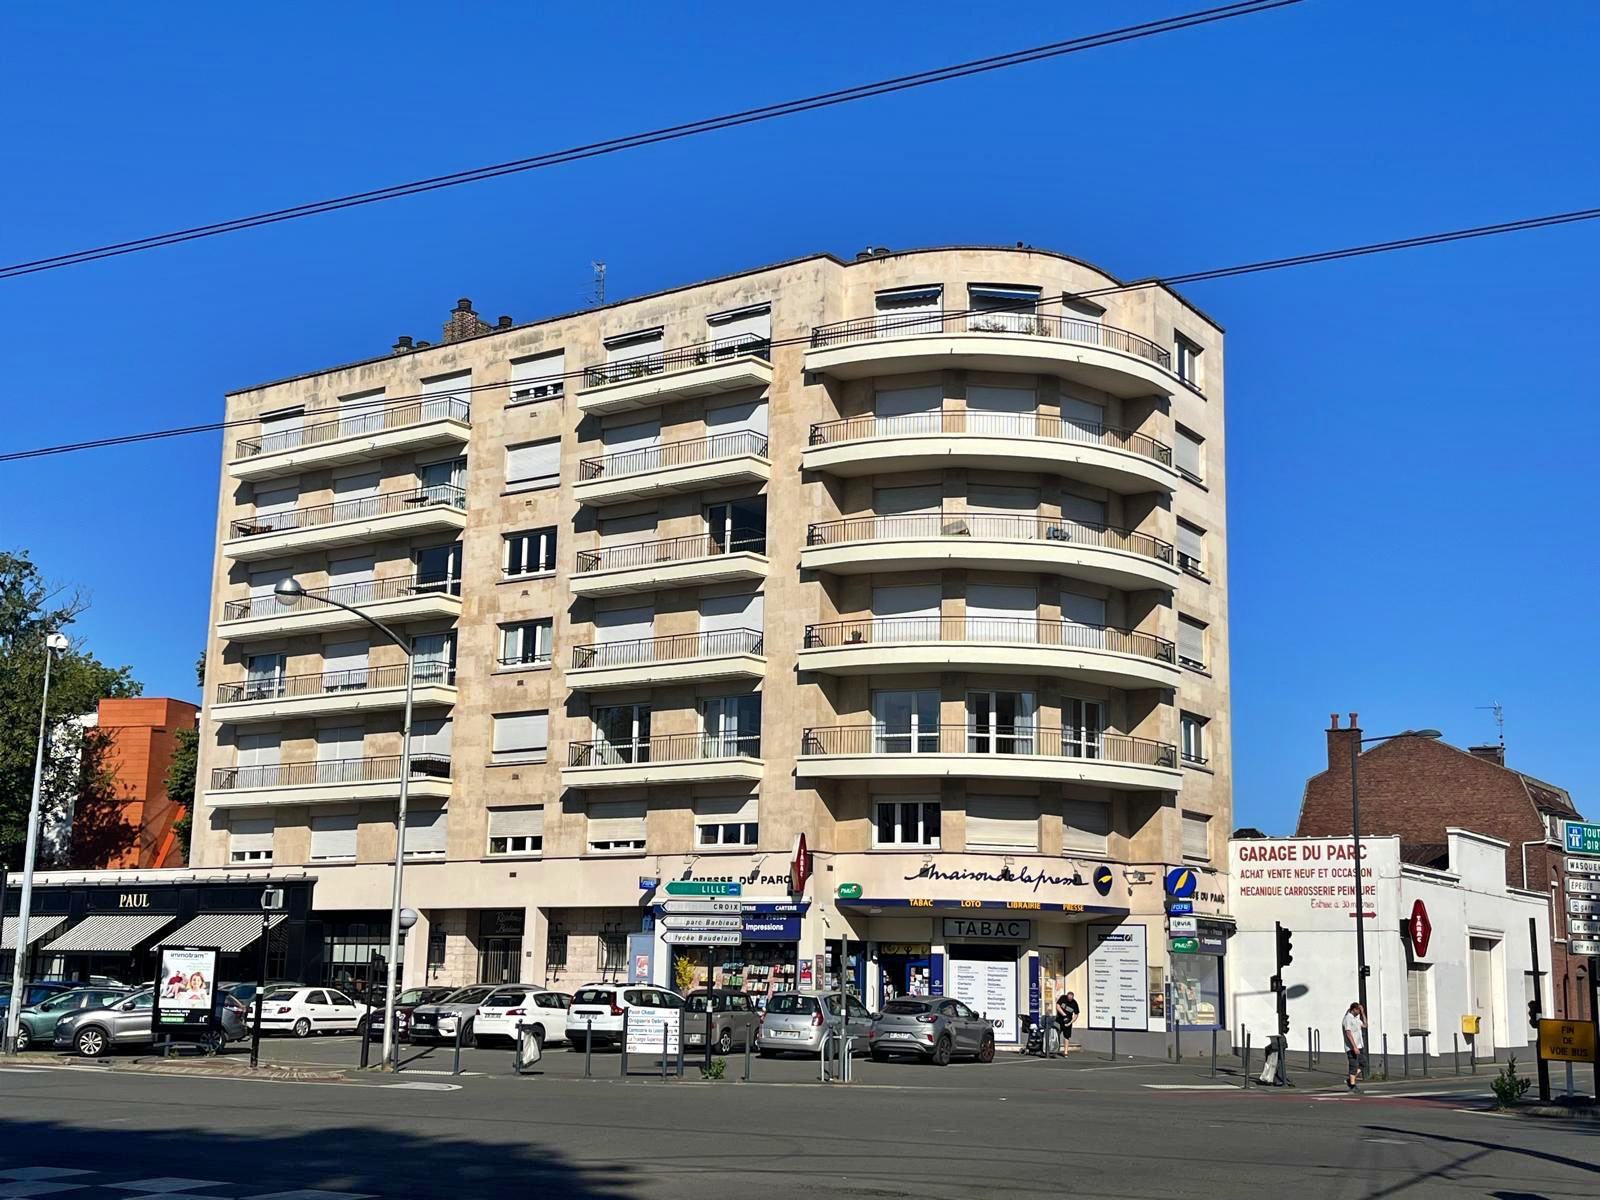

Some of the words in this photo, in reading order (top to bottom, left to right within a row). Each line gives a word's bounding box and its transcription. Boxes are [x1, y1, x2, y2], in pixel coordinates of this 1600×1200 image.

[1240, 845, 1297, 861] GARAGE
[1303, 845, 1320, 860] DU
[1327, 844, 1368, 860] PARC
[1240, 869, 1264, 879] ACHAT
[1268, 868, 1291, 878] VENTE
[1294, 868, 1316, 878] NEUF
[1318, 868, 1328, 878] ET
[1331, 868, 1372, 878] OCCASON
[739, 876, 755, 885] DU
[701, 883, 726, 894] LILLE
[1240, 886, 1282, 896] MECANIQUE
[1284, 886, 1335, 896] CARROSSERIE
[1337, 885, 1376, 896] PEINURE
[119, 894, 150, 908] PAUL
[909, 899, 933, 907] TABAC
[961, 900, 981, 908] LOTO
[713, 903, 739, 911] CROIX
[1006, 902, 1041, 910] LIBRAIRIE
[1063, 903, 1085, 912] PRESSE
[686, 919, 703, 927] parc
[746, 923, 784, 931] Impressions
[954, 921, 1020, 936] TABAC
[698, 934, 738, 942] Baudelaire
[1561, 1026, 1575, 1034] FIN
[1562, 1036, 1574, 1045] DE
[1550, 1046, 1569, 1055] VOIE
[1571, 1047, 1588, 1057] BUS
